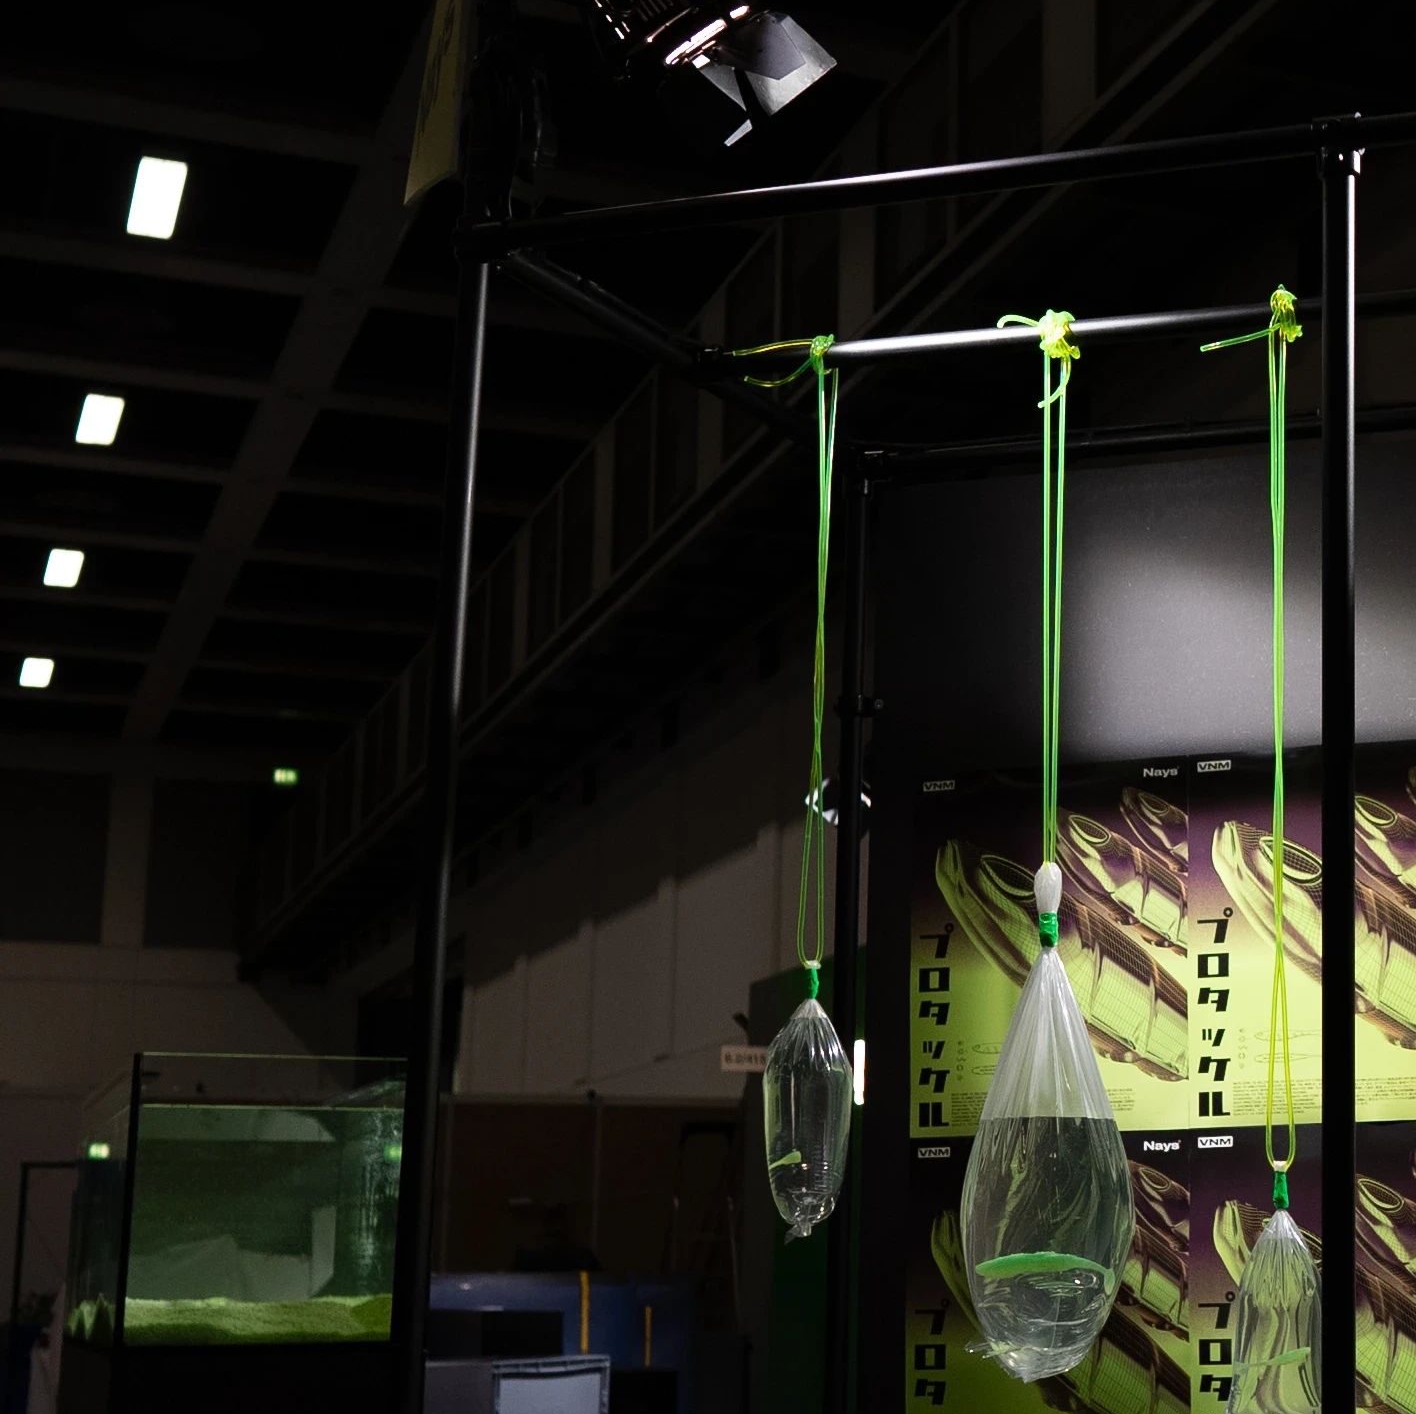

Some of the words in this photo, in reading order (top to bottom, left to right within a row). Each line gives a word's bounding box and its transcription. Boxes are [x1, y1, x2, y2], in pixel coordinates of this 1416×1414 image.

[1198, 762, 1229, 770] VNM
[1143, 768, 1178, 778] Nays
[924, 782, 954, 790] VNM
[1197, 907, 1233, 1116] プロタックル
[919, 923, 954, 1127] プロタックル
[1143, 1140, 1181, 1152] Nays
[1200, 1138, 1231, 1146] VNM
